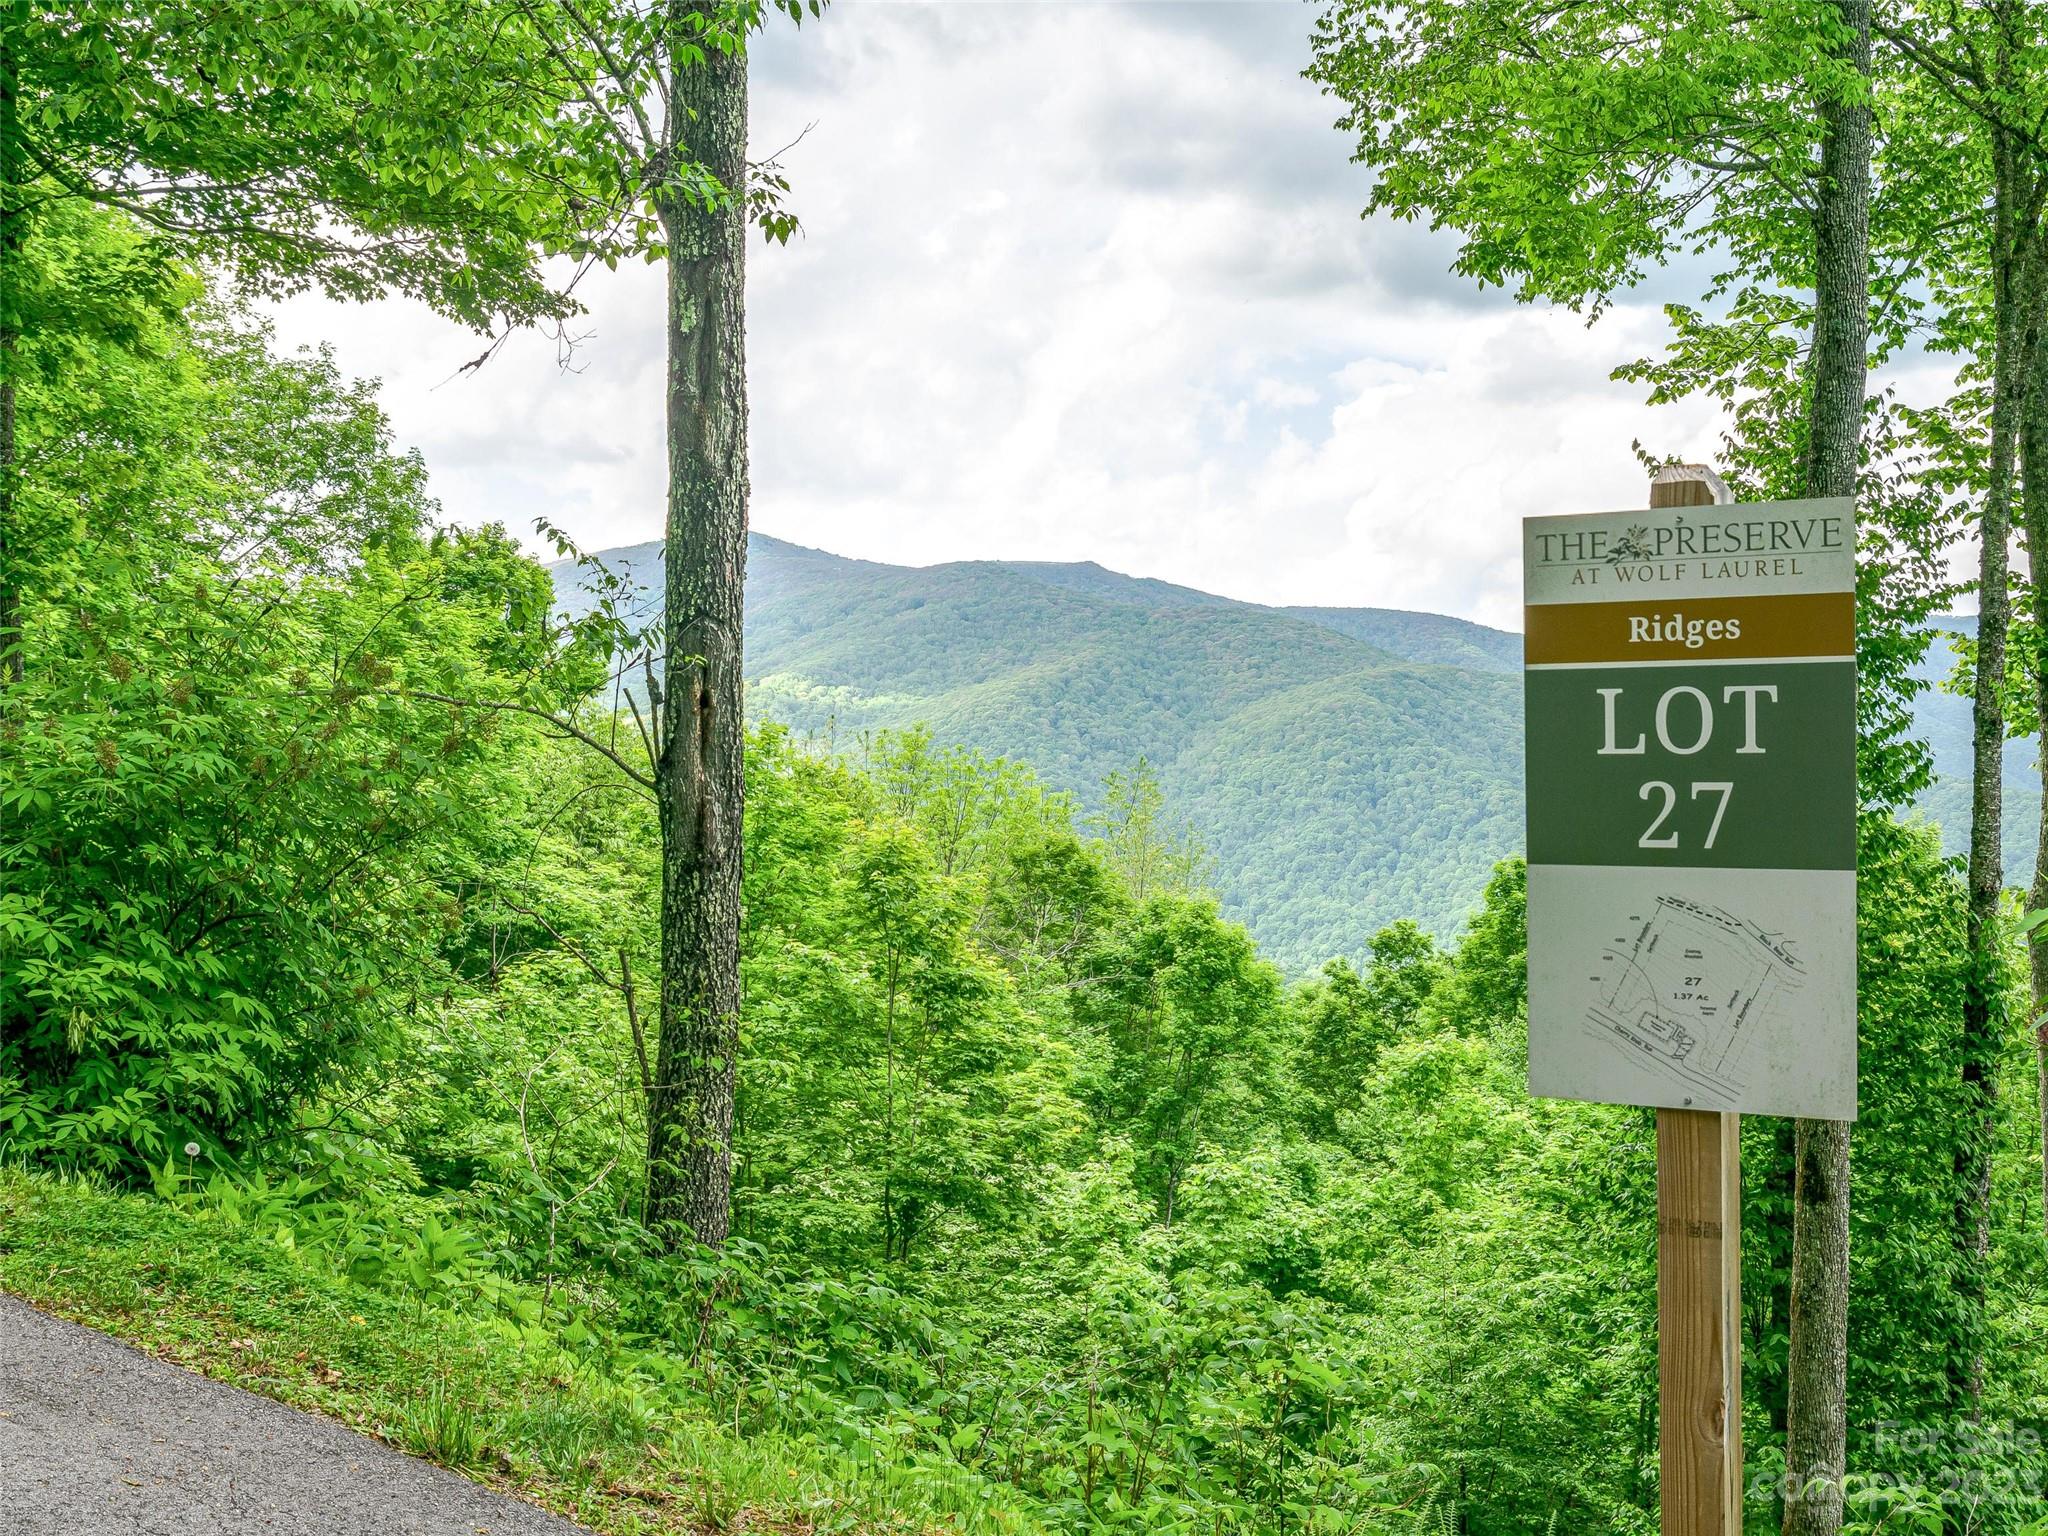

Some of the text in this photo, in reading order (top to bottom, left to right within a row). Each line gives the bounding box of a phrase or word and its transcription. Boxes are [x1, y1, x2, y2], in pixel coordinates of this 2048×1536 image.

[1535, 517, 1843, 562] THE PRESERVE
[1572, 558, 1804, 585] AT WOLF LAUREL
[1628, 613, 1741, 649] Ridges
[1596, 685, 1778, 755] LOT
[1638, 780, 1734, 849] 27
[1673, 992, 1693, 1000] 1.37
[1684, 976, 1703, 986] 27
